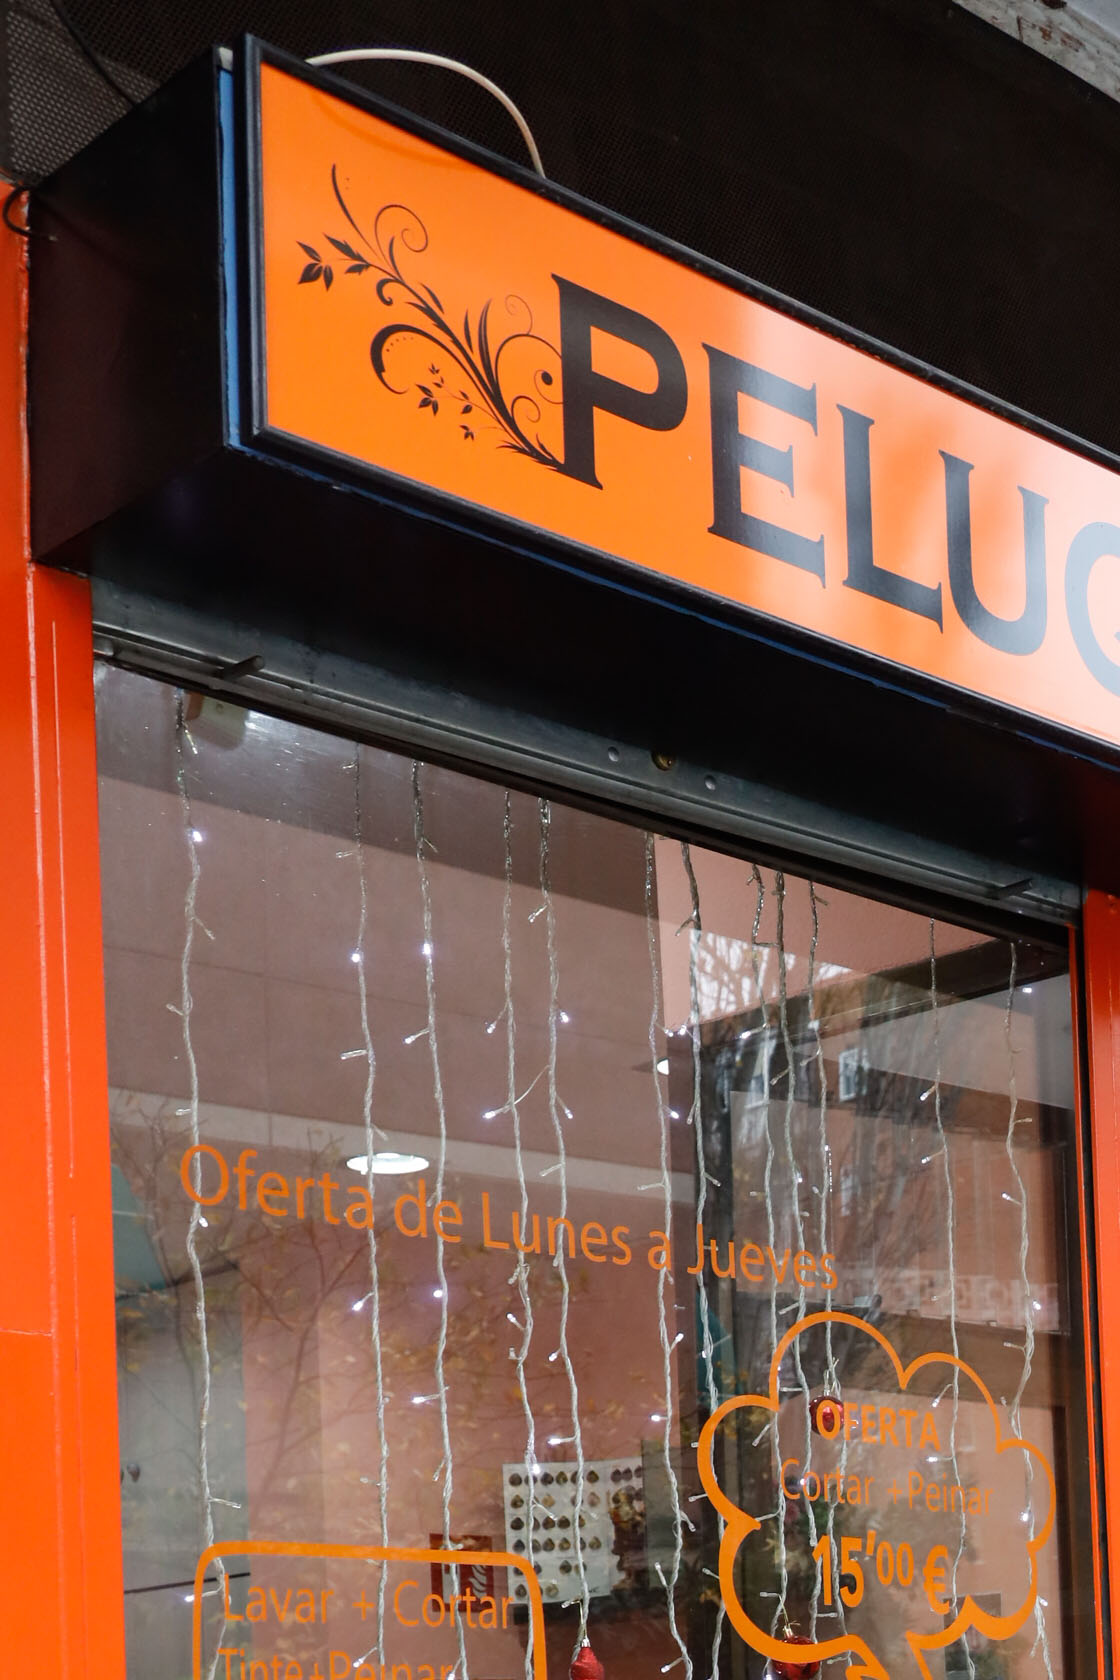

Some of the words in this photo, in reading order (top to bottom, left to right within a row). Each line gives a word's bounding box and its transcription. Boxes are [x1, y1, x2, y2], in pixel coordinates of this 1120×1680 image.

[180, 1143, 375, 1230] Oferta
[394, 1179, 463, 1244] de
[482, 1191, 632, 1267] Lunes
[647, 1228, 672, 1272] a
[686, 1223, 840, 1292] Jueves
[816, 1399, 941, 1451] OFERTA
[781, 1458, 875, 1506] Cortar
[224, 1572, 333, 1625] Lavar
[394, 1579, 514, 1629] Cortar
